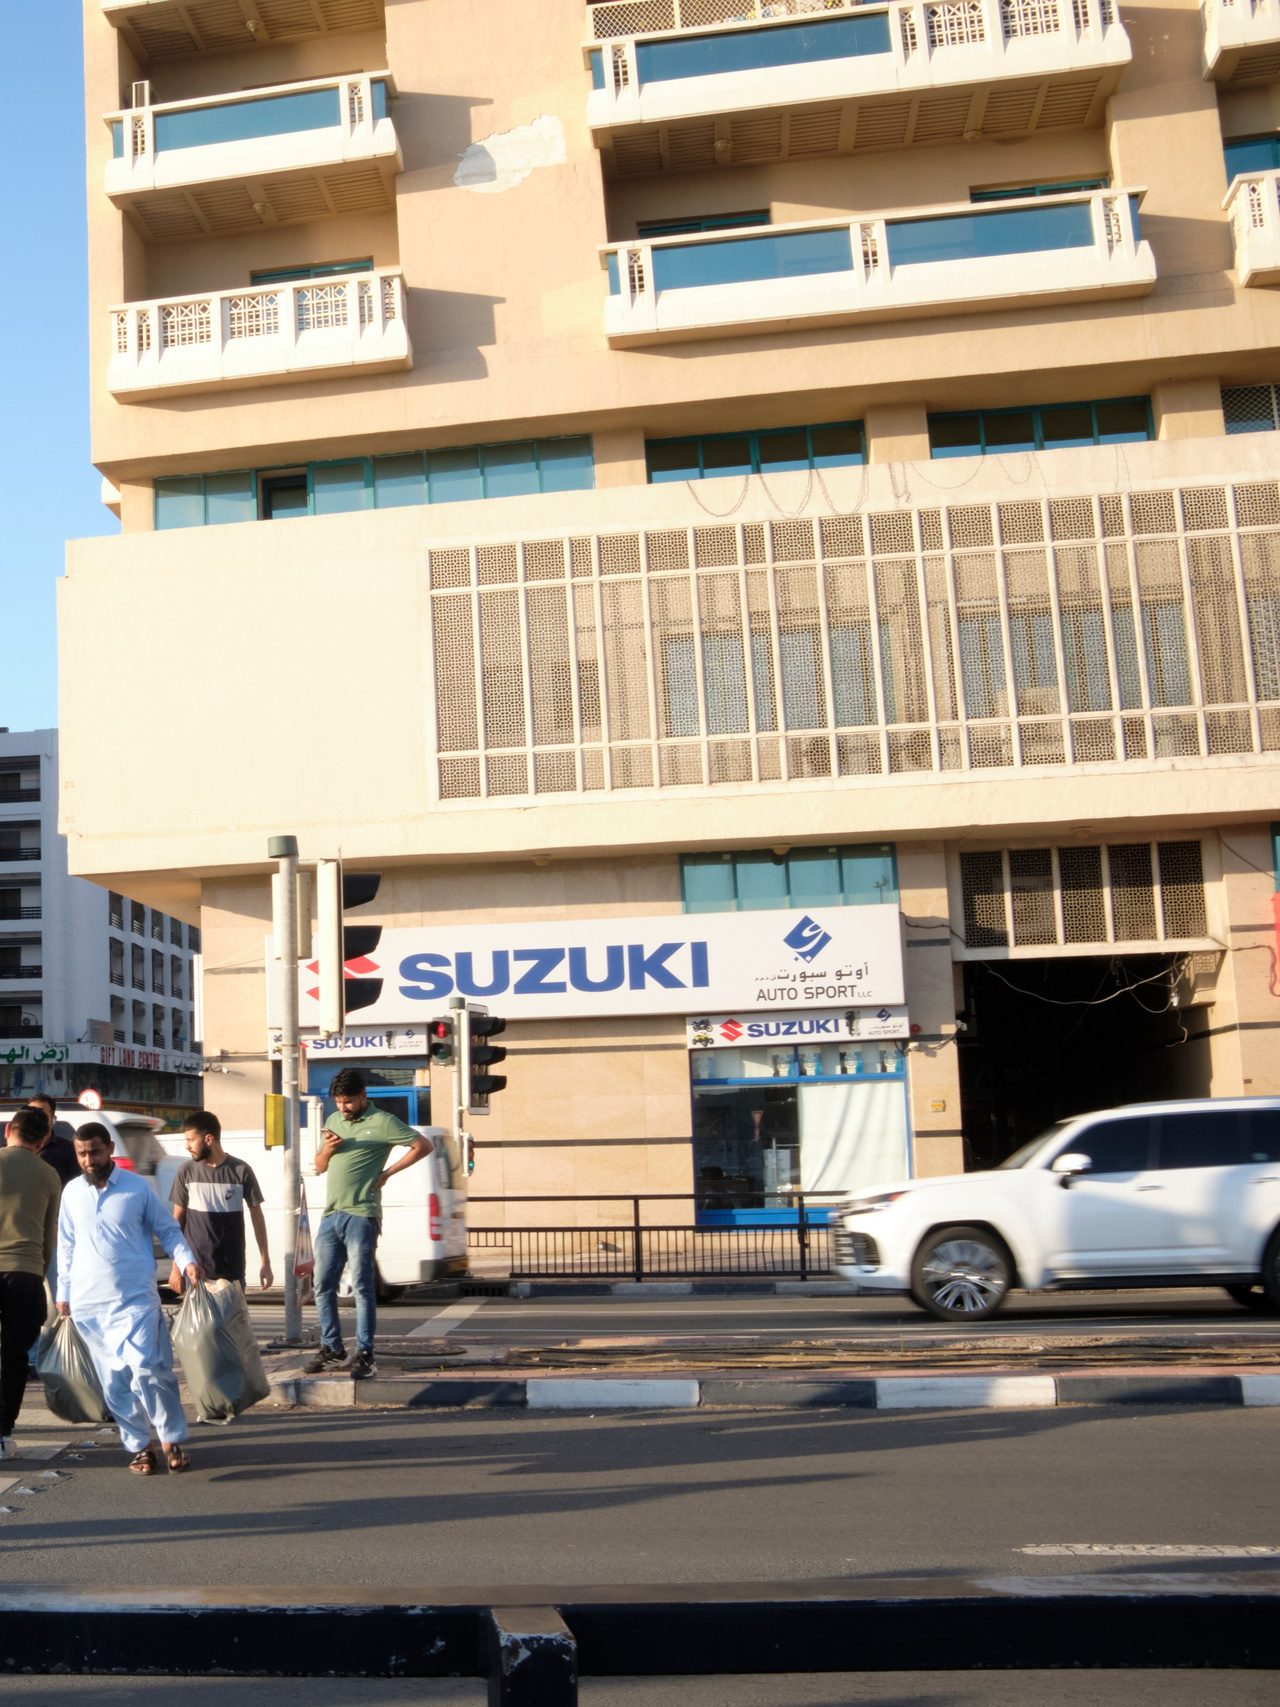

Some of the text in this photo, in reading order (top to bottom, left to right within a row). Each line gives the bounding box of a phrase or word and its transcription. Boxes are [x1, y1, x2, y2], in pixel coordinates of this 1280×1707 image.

[398, 941, 710, 1000] SUZUKI
[777, 968, 827, 983] سبورت
[835, 961, 870, 982] أوتو
[756, 985, 872, 1002] AUTO SPORT LLC
[746, 1018, 840, 1038] SUZUKI
[312, 1035, 384, 1050] SUZUKI
[100, 1046, 115, 1065] GIFT
[118, 1048, 135, 1067] LAND
[138, 1051, 160, 1071] CENTRE
